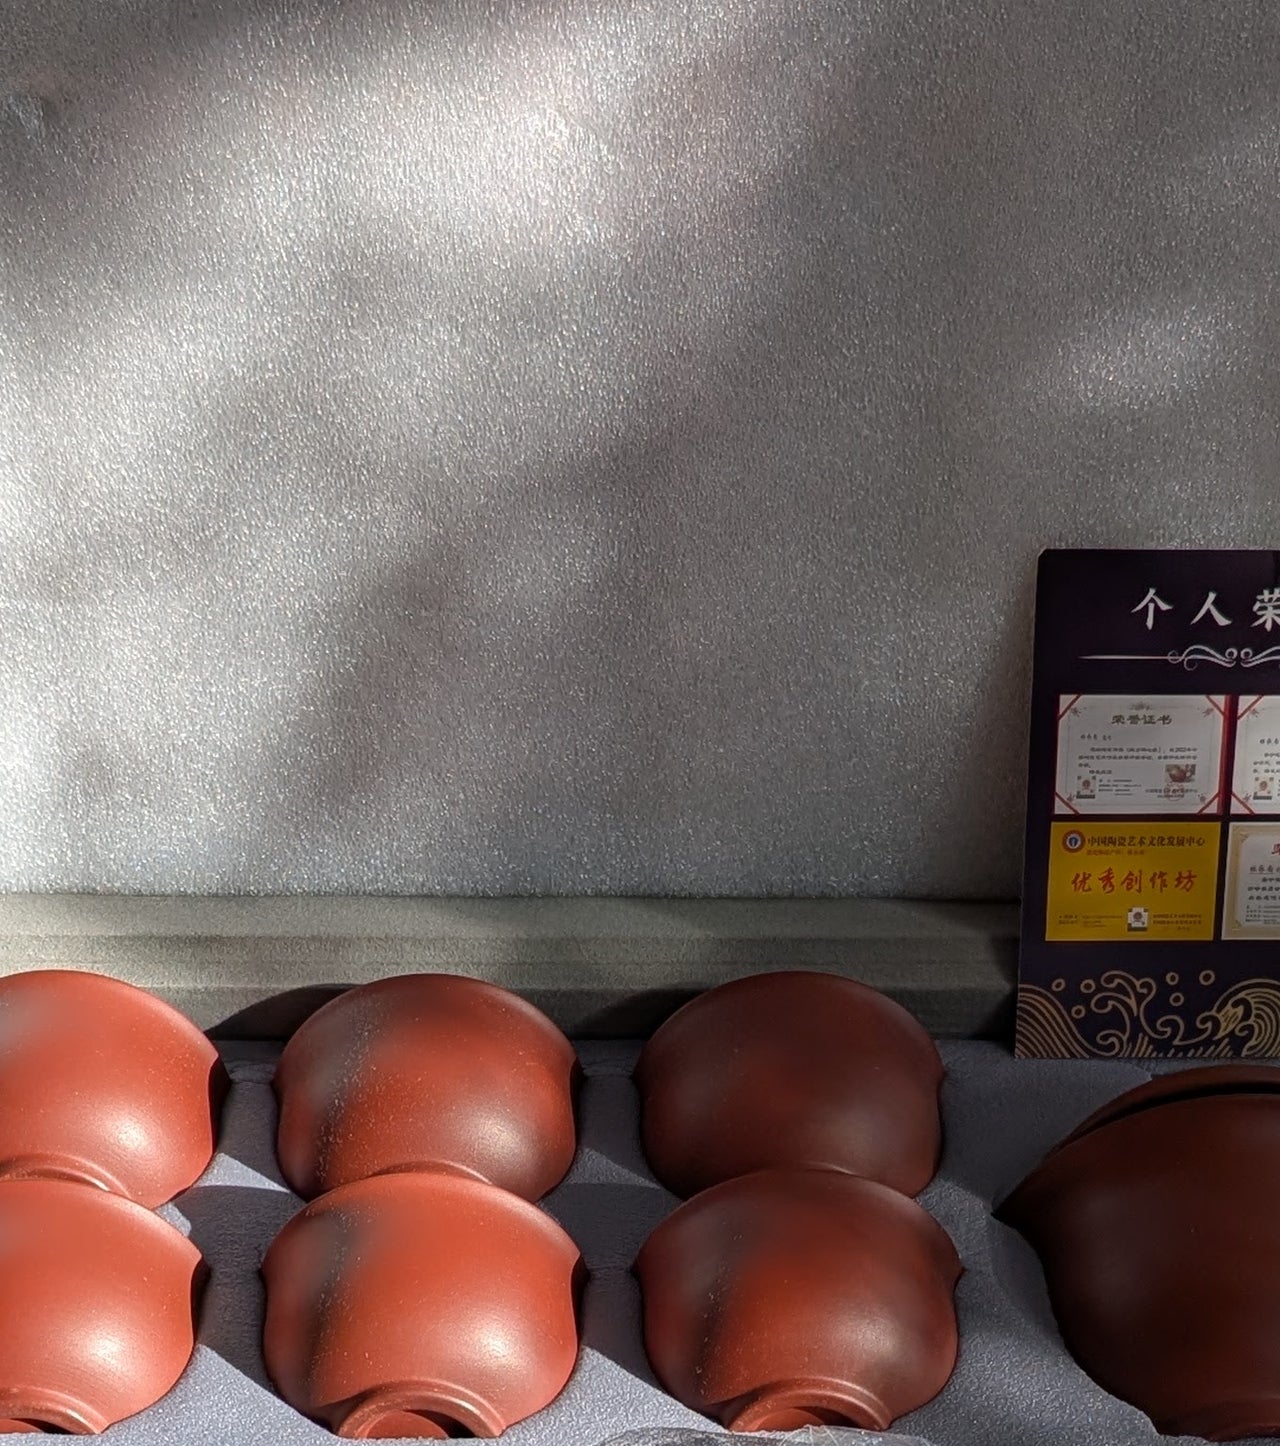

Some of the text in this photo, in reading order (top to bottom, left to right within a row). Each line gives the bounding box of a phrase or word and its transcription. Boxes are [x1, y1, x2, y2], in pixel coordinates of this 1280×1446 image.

[1111, 714, 1172, 725] 荣誉证书
[1071, 867, 1198, 894] 优秀创作坊
